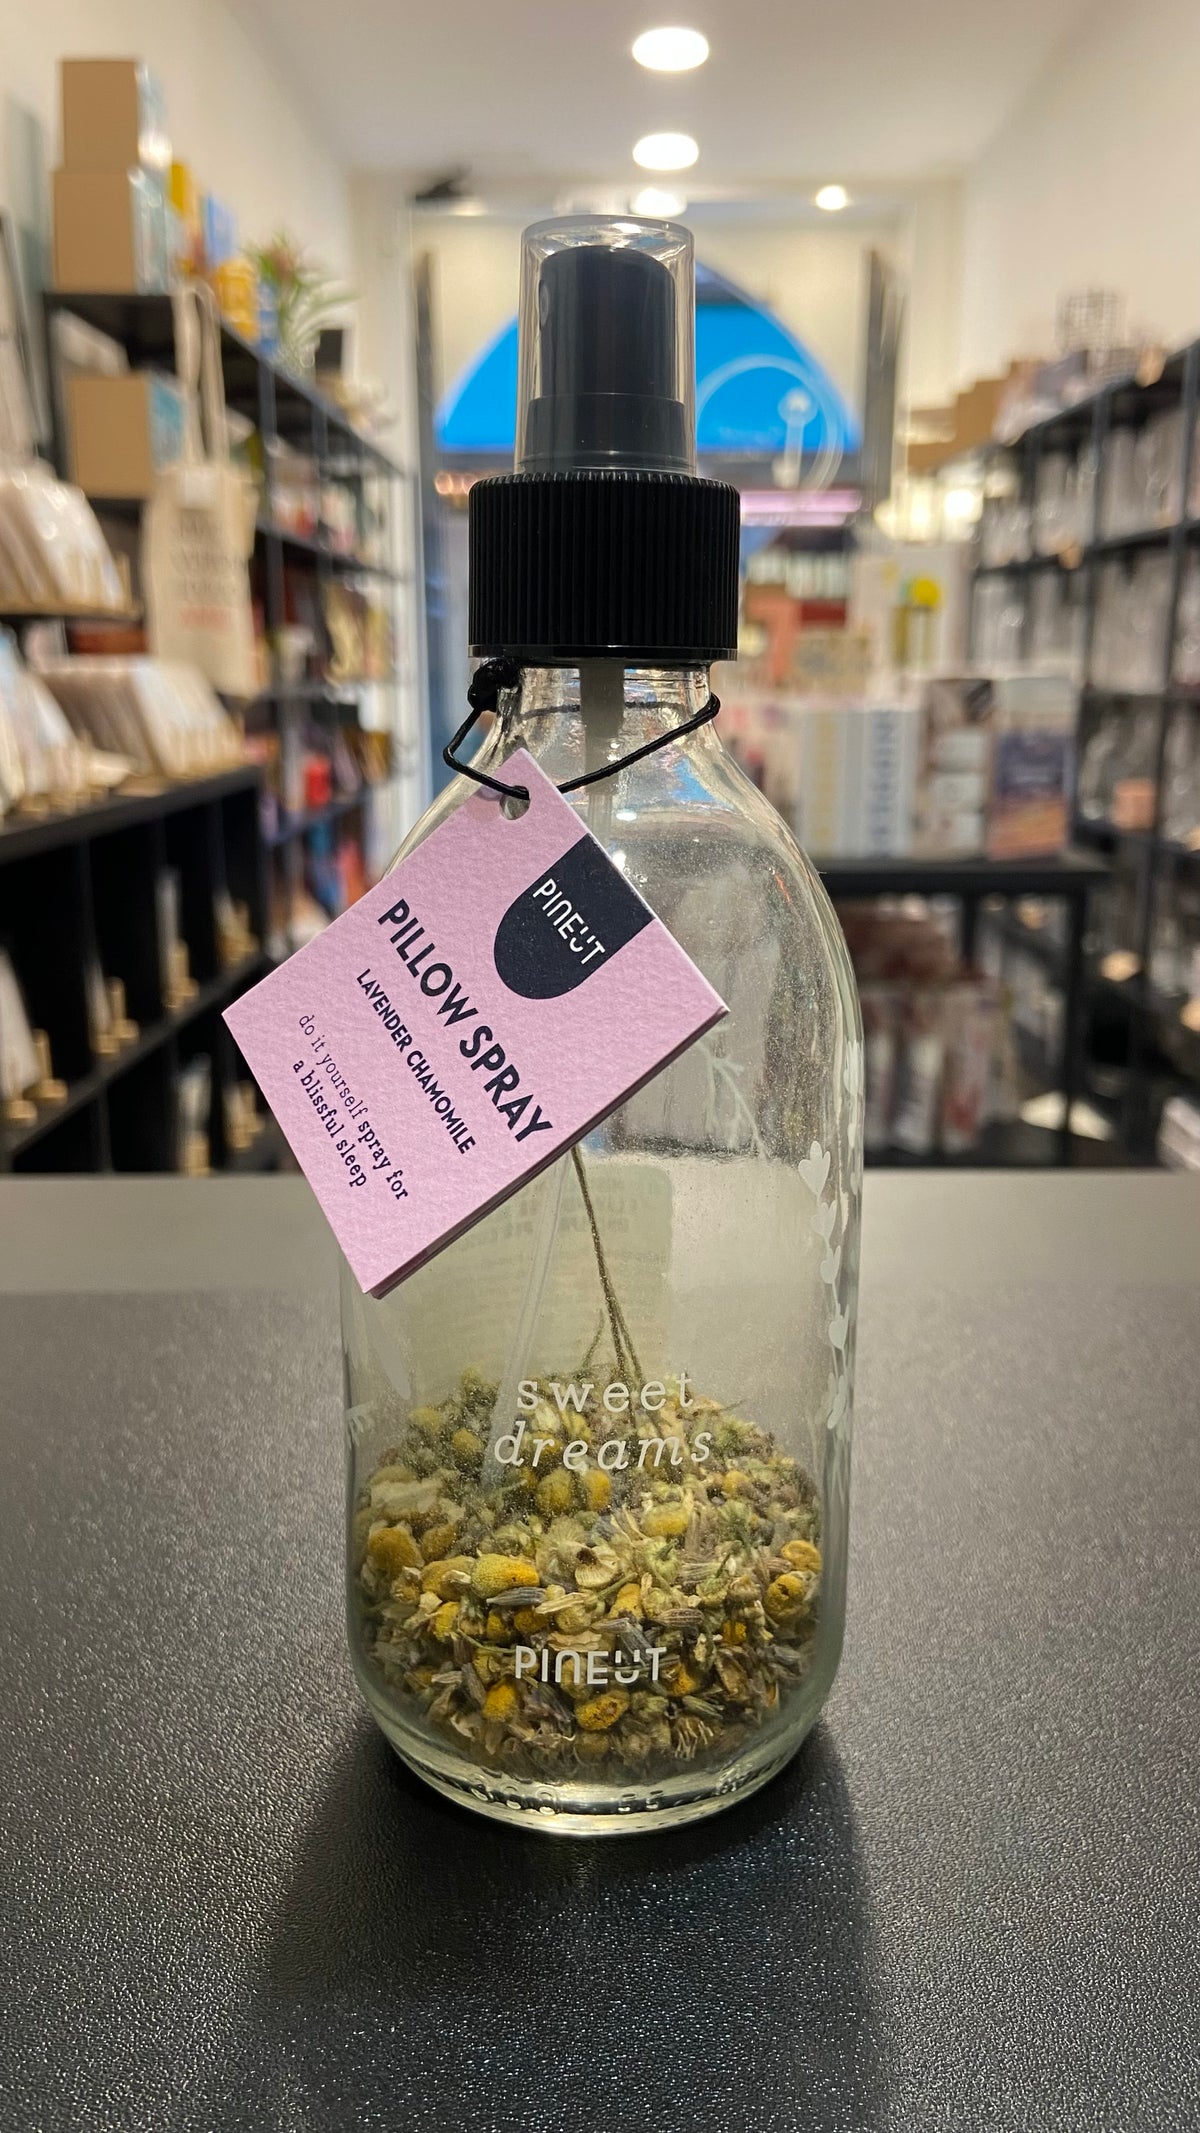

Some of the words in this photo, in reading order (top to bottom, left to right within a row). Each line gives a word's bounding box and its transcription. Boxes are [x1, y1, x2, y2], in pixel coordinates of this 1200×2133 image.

[532, 878, 606, 966] PINEUT
[299, 1014, 315, 1036] do
[311, 1034, 326, 1053] it
[378, 898, 478, 1027] PILLOW
[459, 1025, 554, 1143] SPRAY
[316, 1053, 368, 1119] yourself
[356, 968, 413, 1053] LAVENDER
[406, 1050, 476, 1155] CHAMOMILE
[293, 1060, 305, 1073] a
[300, 1069, 345, 1139] blissful
[336, 1139, 367, 1188] sleep
[358, 1120, 391, 1170] spray
[386, 1169, 409, 1200] for
[516, 1372, 694, 1413] sweet
[493, 1421, 712, 1470] dreams
[514, 1645, 668, 1686] PINEUT
